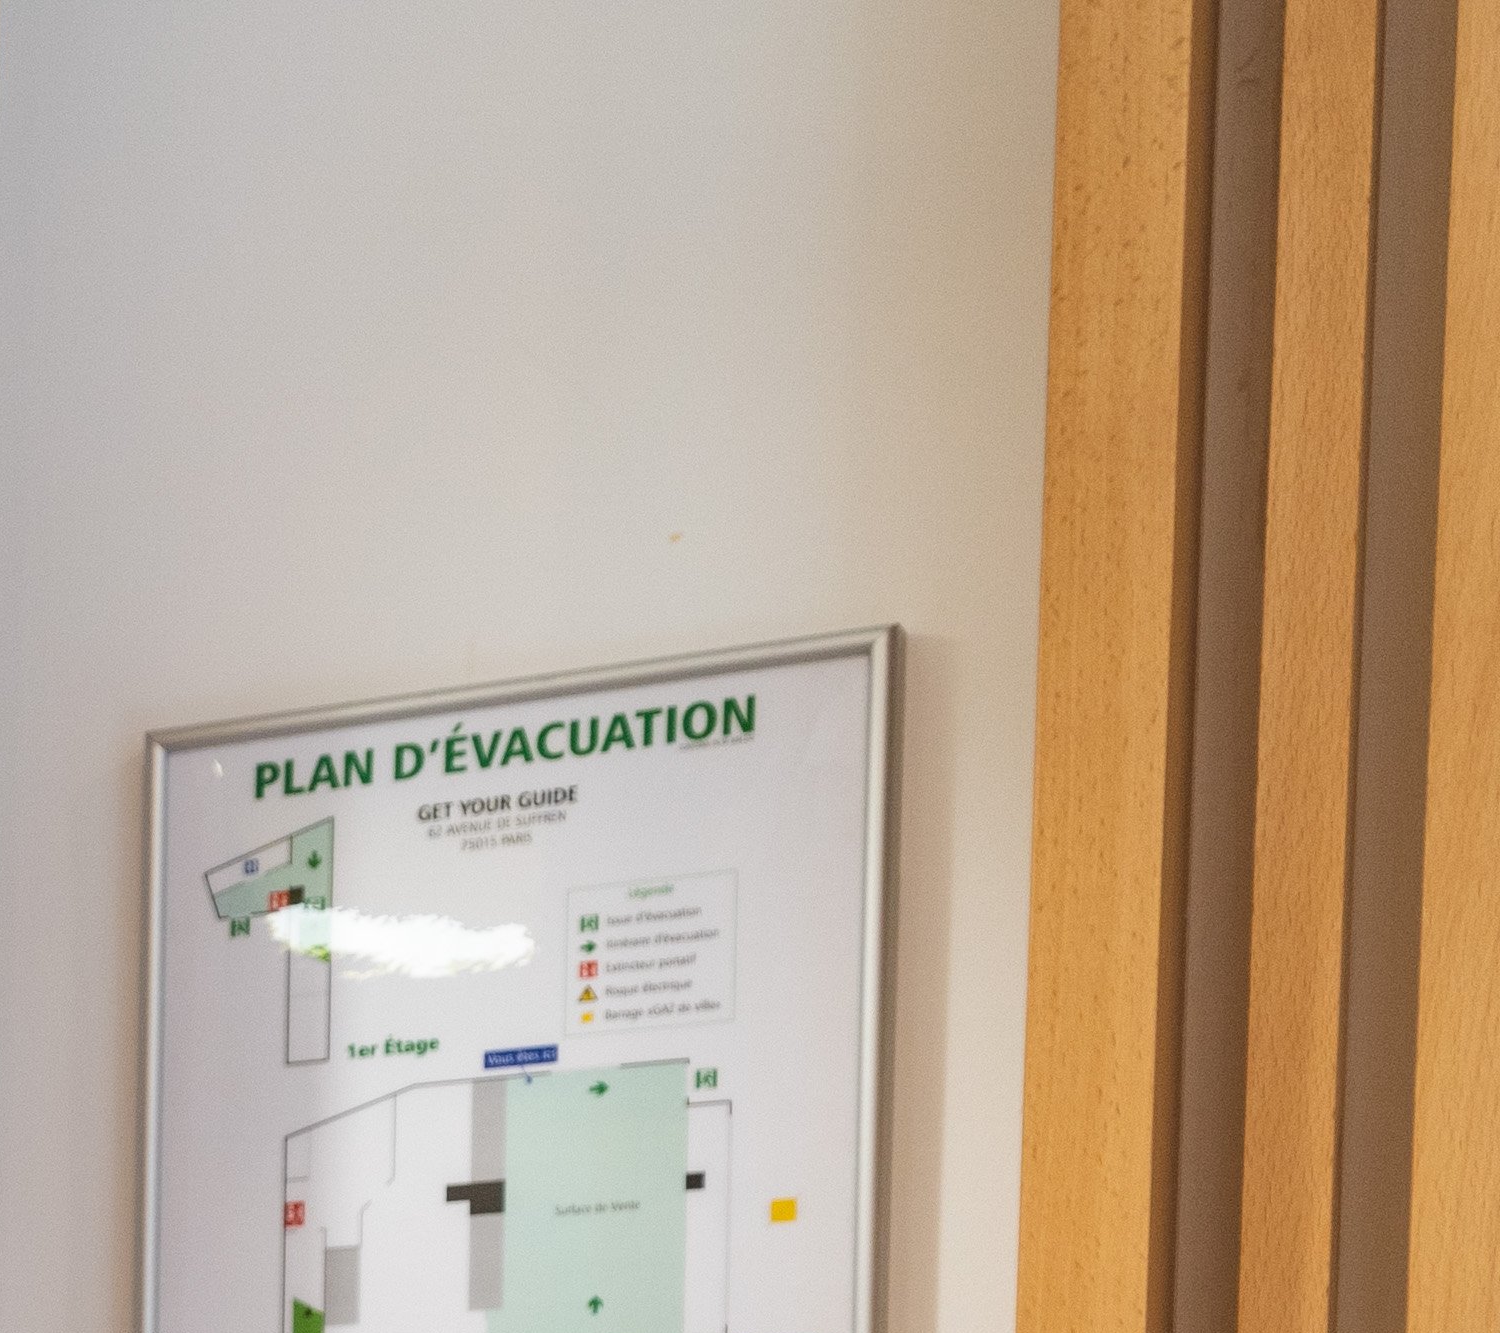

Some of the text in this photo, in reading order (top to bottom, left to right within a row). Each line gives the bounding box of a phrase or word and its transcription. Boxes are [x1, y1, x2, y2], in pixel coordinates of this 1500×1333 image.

[253, 694, 757, 800] PLAN D'ÉVACUATION
[417, 785, 578, 822] GET YOUR GUIDE
[447, 820, 491, 836] AVENUE
[501, 831, 533, 845] PARIS
[348, 1034, 440, 1059] 1er Étage
